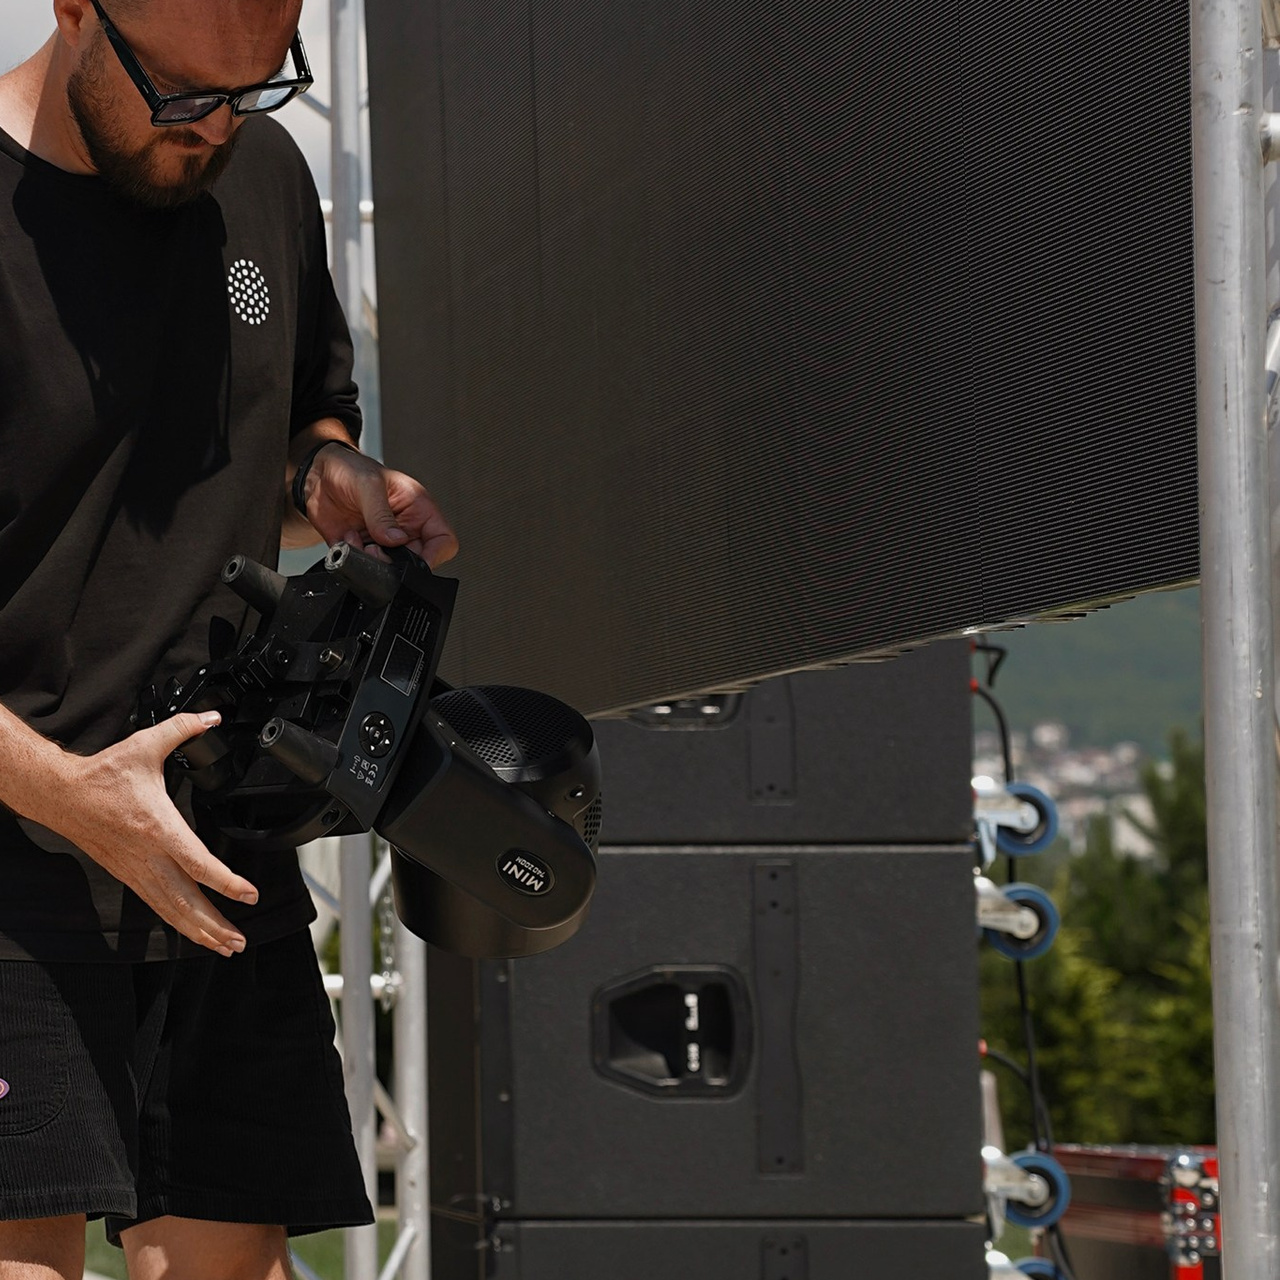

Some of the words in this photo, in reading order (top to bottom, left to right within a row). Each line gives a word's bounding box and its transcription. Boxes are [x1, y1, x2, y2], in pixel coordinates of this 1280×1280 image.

[515, 856, 533, 871] ZOOM
[502, 861, 544, 891] MINI
[532, 867, 546, 878] 740
